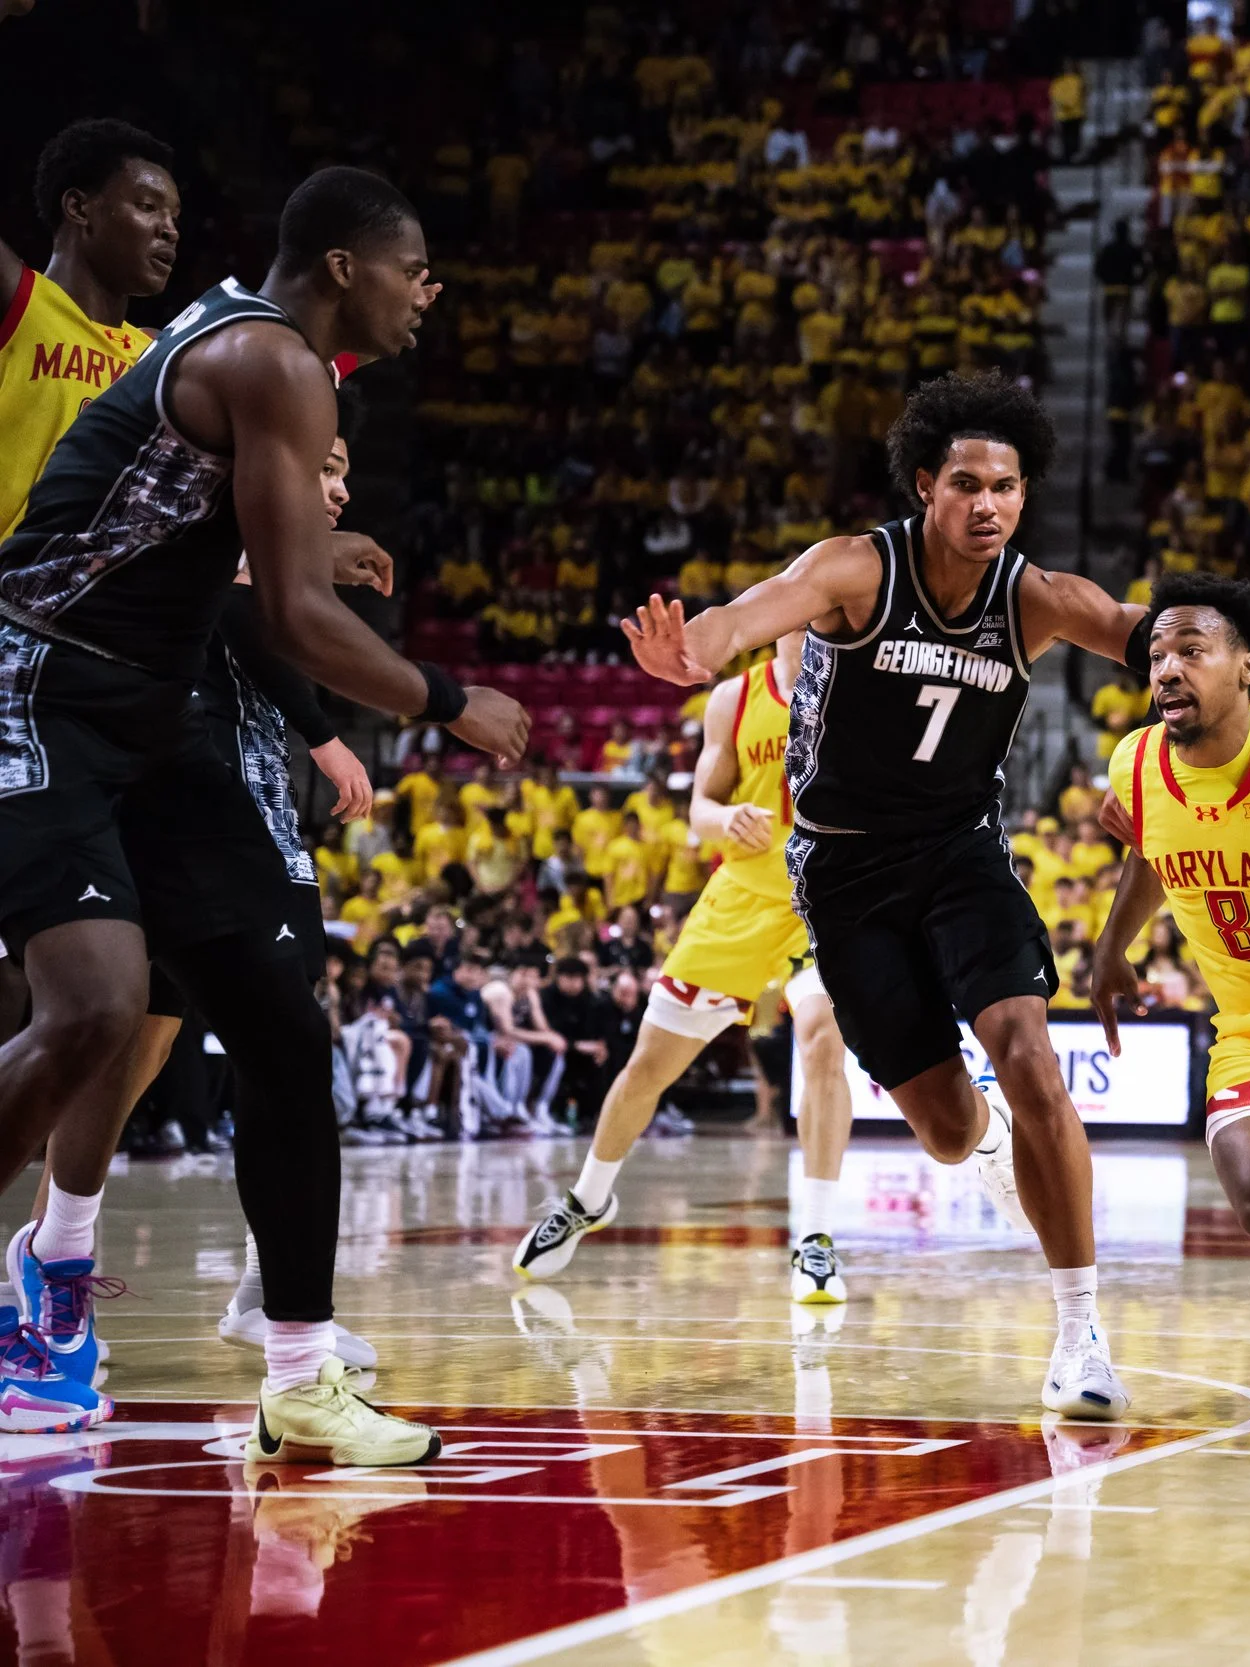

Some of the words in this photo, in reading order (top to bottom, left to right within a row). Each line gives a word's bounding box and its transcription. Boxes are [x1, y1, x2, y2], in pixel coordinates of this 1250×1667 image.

[29, 342, 134, 389] MARY
[995, 614, 1005, 622] THE
[873, 640, 1013, 692] GEORGETOWN
[912, 684, 962, 762] 7
